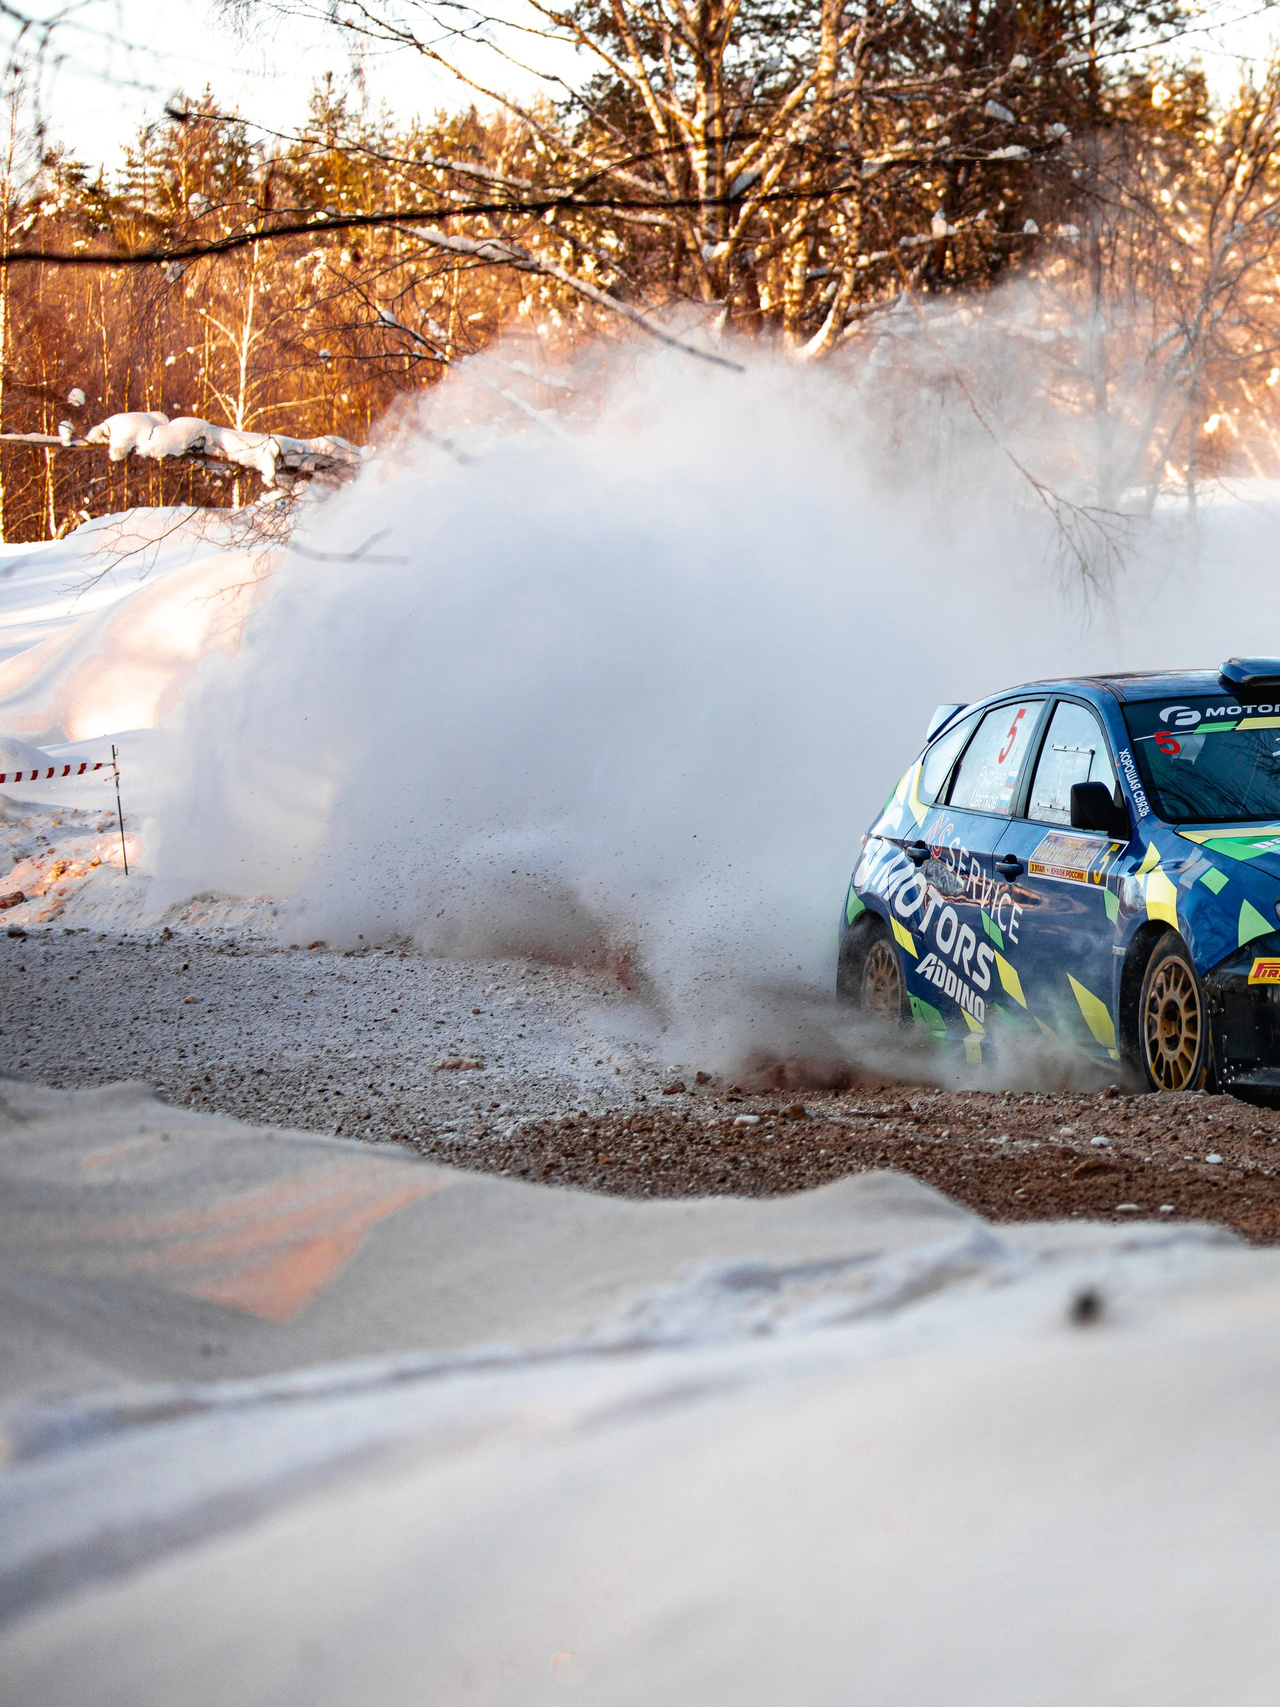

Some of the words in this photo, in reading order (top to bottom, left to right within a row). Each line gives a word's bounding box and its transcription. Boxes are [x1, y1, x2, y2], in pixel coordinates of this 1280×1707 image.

[998, 708, 1027, 764] 5
[1154, 730, 1181, 755] 5
[1118, 747, 1142, 792] ХОРОШАЯ
[1132, 790, 1151, 817] СВЯЗЬ
[945, 836, 1023, 945] SERVICE
[1065, 869, 1084, 880] РОССИИ
[1093, 843, 1121, 885] 5
[871, 850, 995, 992] MOTORS
